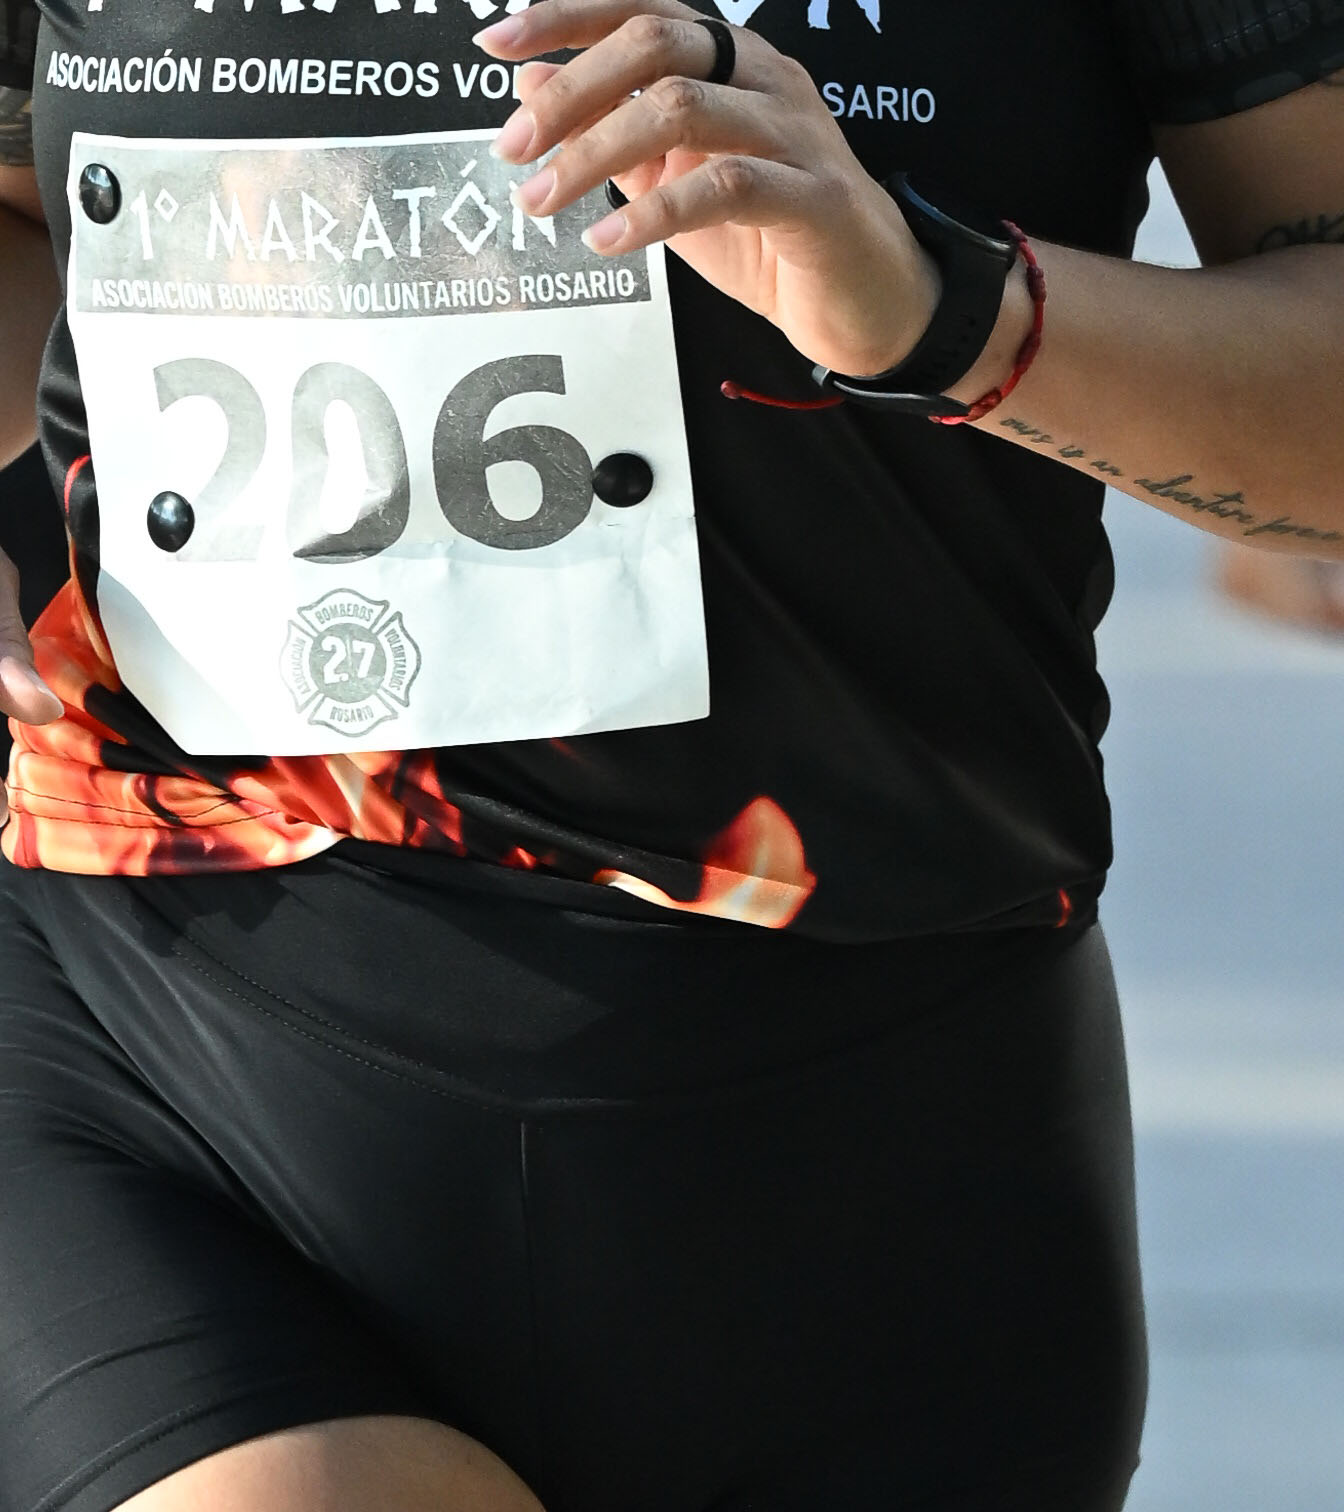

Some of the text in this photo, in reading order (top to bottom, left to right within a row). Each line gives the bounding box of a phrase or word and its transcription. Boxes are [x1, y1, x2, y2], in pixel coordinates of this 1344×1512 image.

[46, 49, 936, 124] ASOCIACIÓN BOMBEROS VO SARIO
[206, 159, 557, 262] MARATÓN
[217, 283, 332, 313] BOMBEROS
[337, 274, 512, 313] VOLUNTARIOS
[519, 267, 636, 303] ROSARIO
[153, 353, 594, 564] 206
[314, 603, 374, 625] BOMBEROS
[321, 636, 376, 685] 27
[329, 705, 374, 723] ROSARIO
